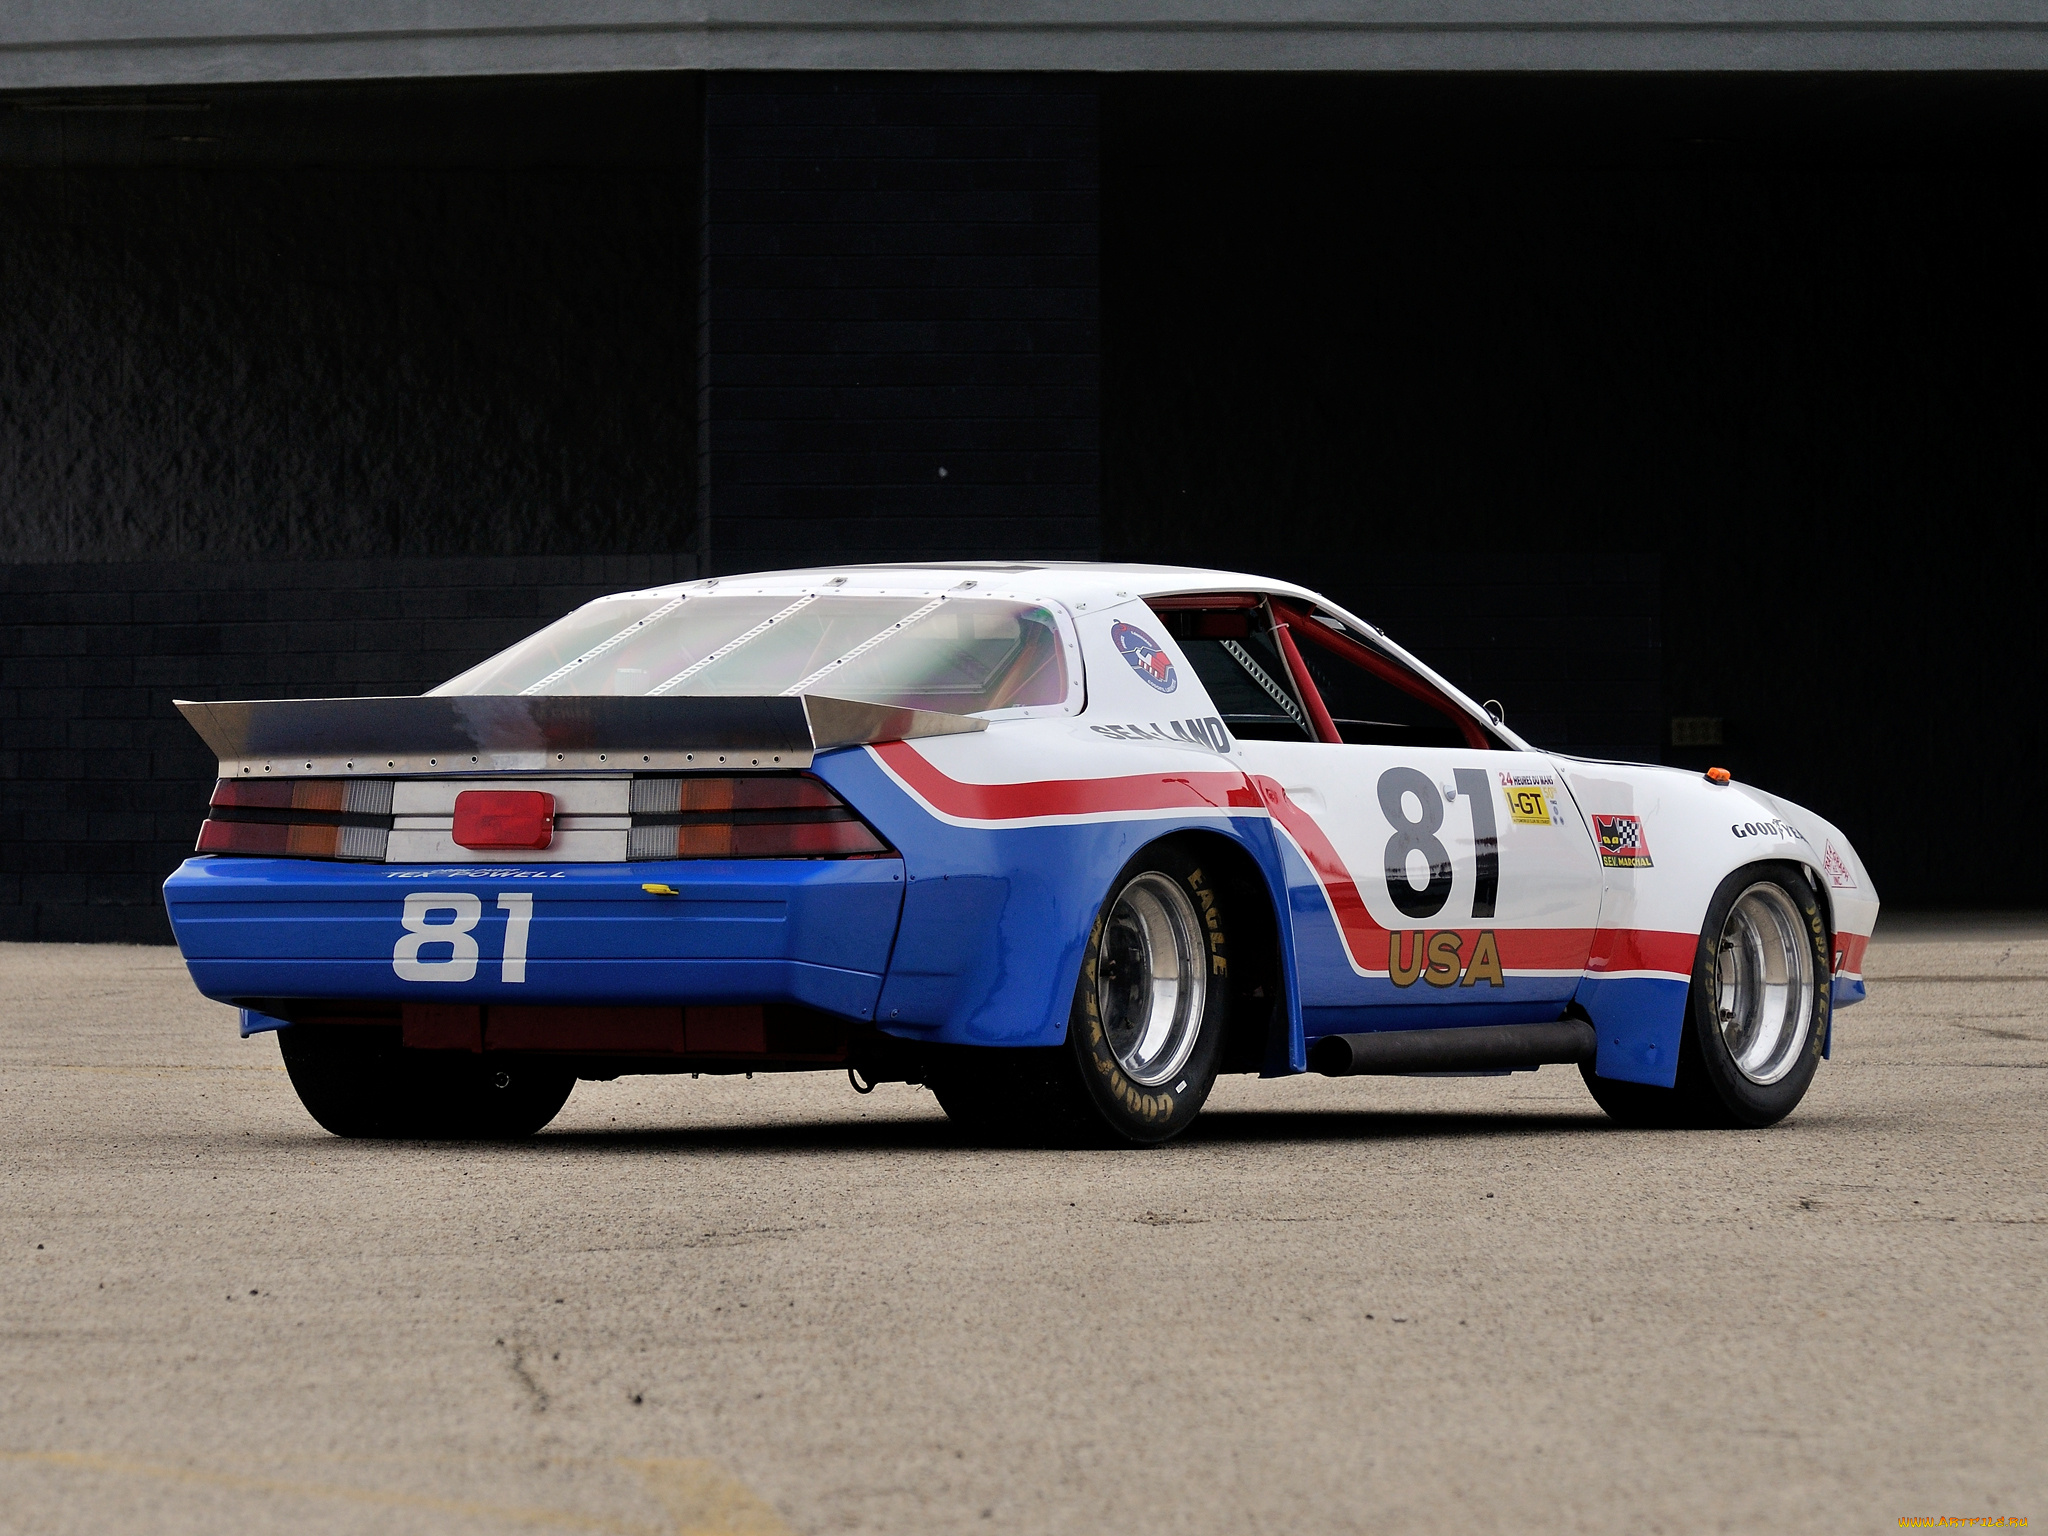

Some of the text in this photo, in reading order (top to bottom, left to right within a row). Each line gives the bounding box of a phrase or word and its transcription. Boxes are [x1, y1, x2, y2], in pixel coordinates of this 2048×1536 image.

[1089, 717, 1231, 754] SEA-LAND
[1498, 771, 1554, 786] 24 HEURES DU MANS
[1506, 792, 1543, 815] I-GT
[1376, 766, 1500, 919] 81
[1730, 818, 1809, 843] GOODYEA
[387, 871, 432, 879] TEX
[448, 870, 566, 879] POWELL
[1618, 857, 1652, 867] MARCHAL
[391, 892, 534, 984] 81
[1187, 867, 1228, 978] EAGLE
[1388, 929, 1505, 989] USA
